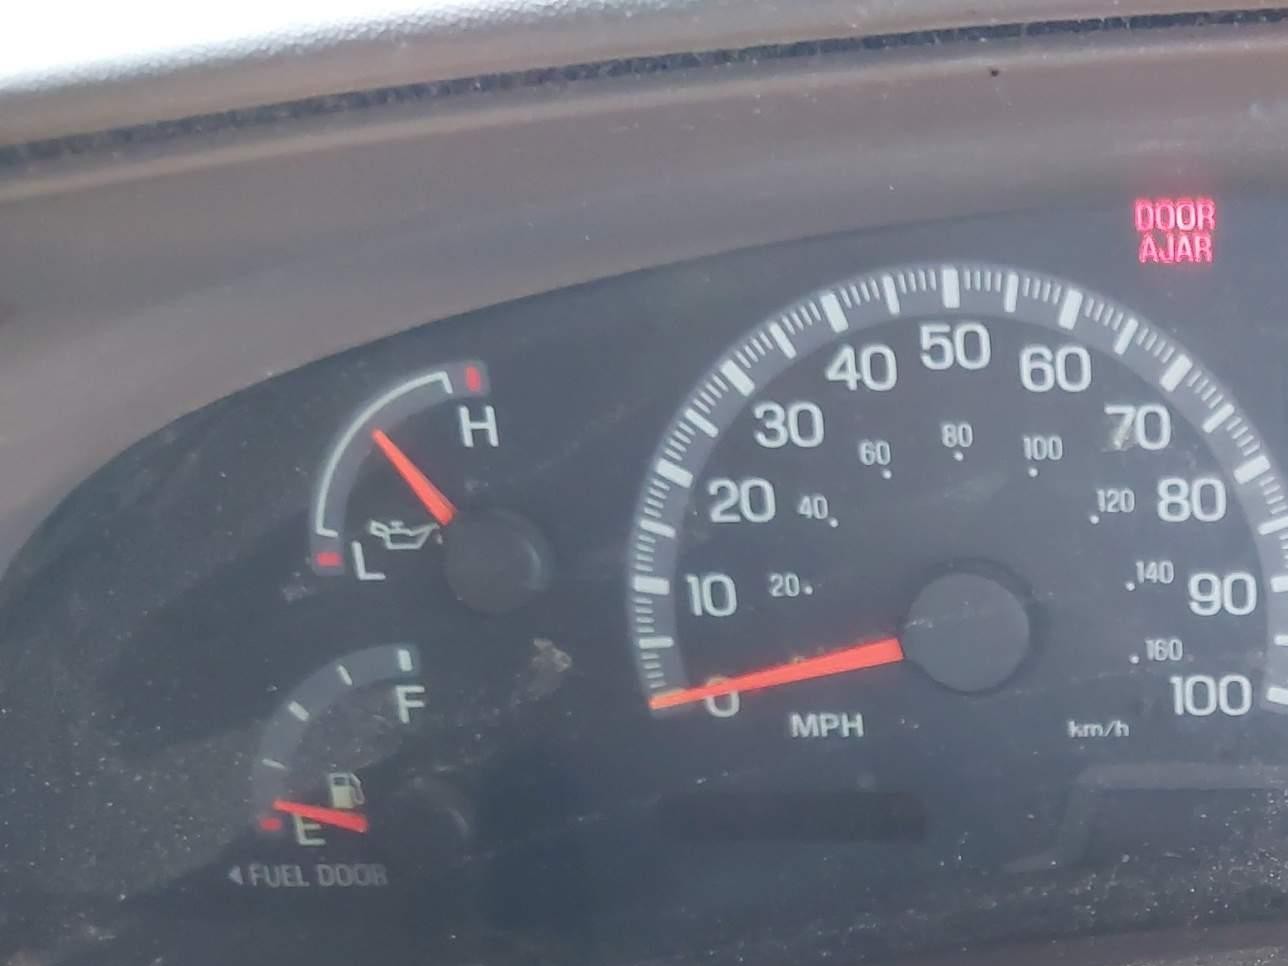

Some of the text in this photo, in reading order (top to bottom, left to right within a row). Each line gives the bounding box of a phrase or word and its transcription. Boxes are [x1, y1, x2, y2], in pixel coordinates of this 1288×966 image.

[1135, 199, 1215, 231] DOOR
[1138, 233, 1214, 263] AJAR
[920, 323, 992, 370] 50
[826, 345, 897, 391] 40
[1019, 346, 1092, 392] 60
[459, 405, 500, 448] H
[754, 403, 825, 448] 30
[941, 424, 973, 449] 80
[1104, 404, 1172, 450] 70
[859, 442, 891, 466] 60
[1023, 436, 1063, 461] 100
[708, 480, 777, 523] 20
[799, 496, 829, 519] 40
[1097, 489, 1135, 514] 120
[1156, 479, 1227, 522] 80
[351, 541, 386, 580] L
[1136, 562, 1174, 585] 140
[686, 574, 738, 616] 10
[769, 574, 799, 597] 20
[1188, 574, 1257, 616] 90
[1145, 640, 1183, 662] 160
[395, 685, 426, 723] F
[1170, 676, 1252, 717] 100
[791, 715, 863, 738] MPH
[1068, 721, 1129, 740] km/h
[249, 866, 388, 888] FUEL DOOR
